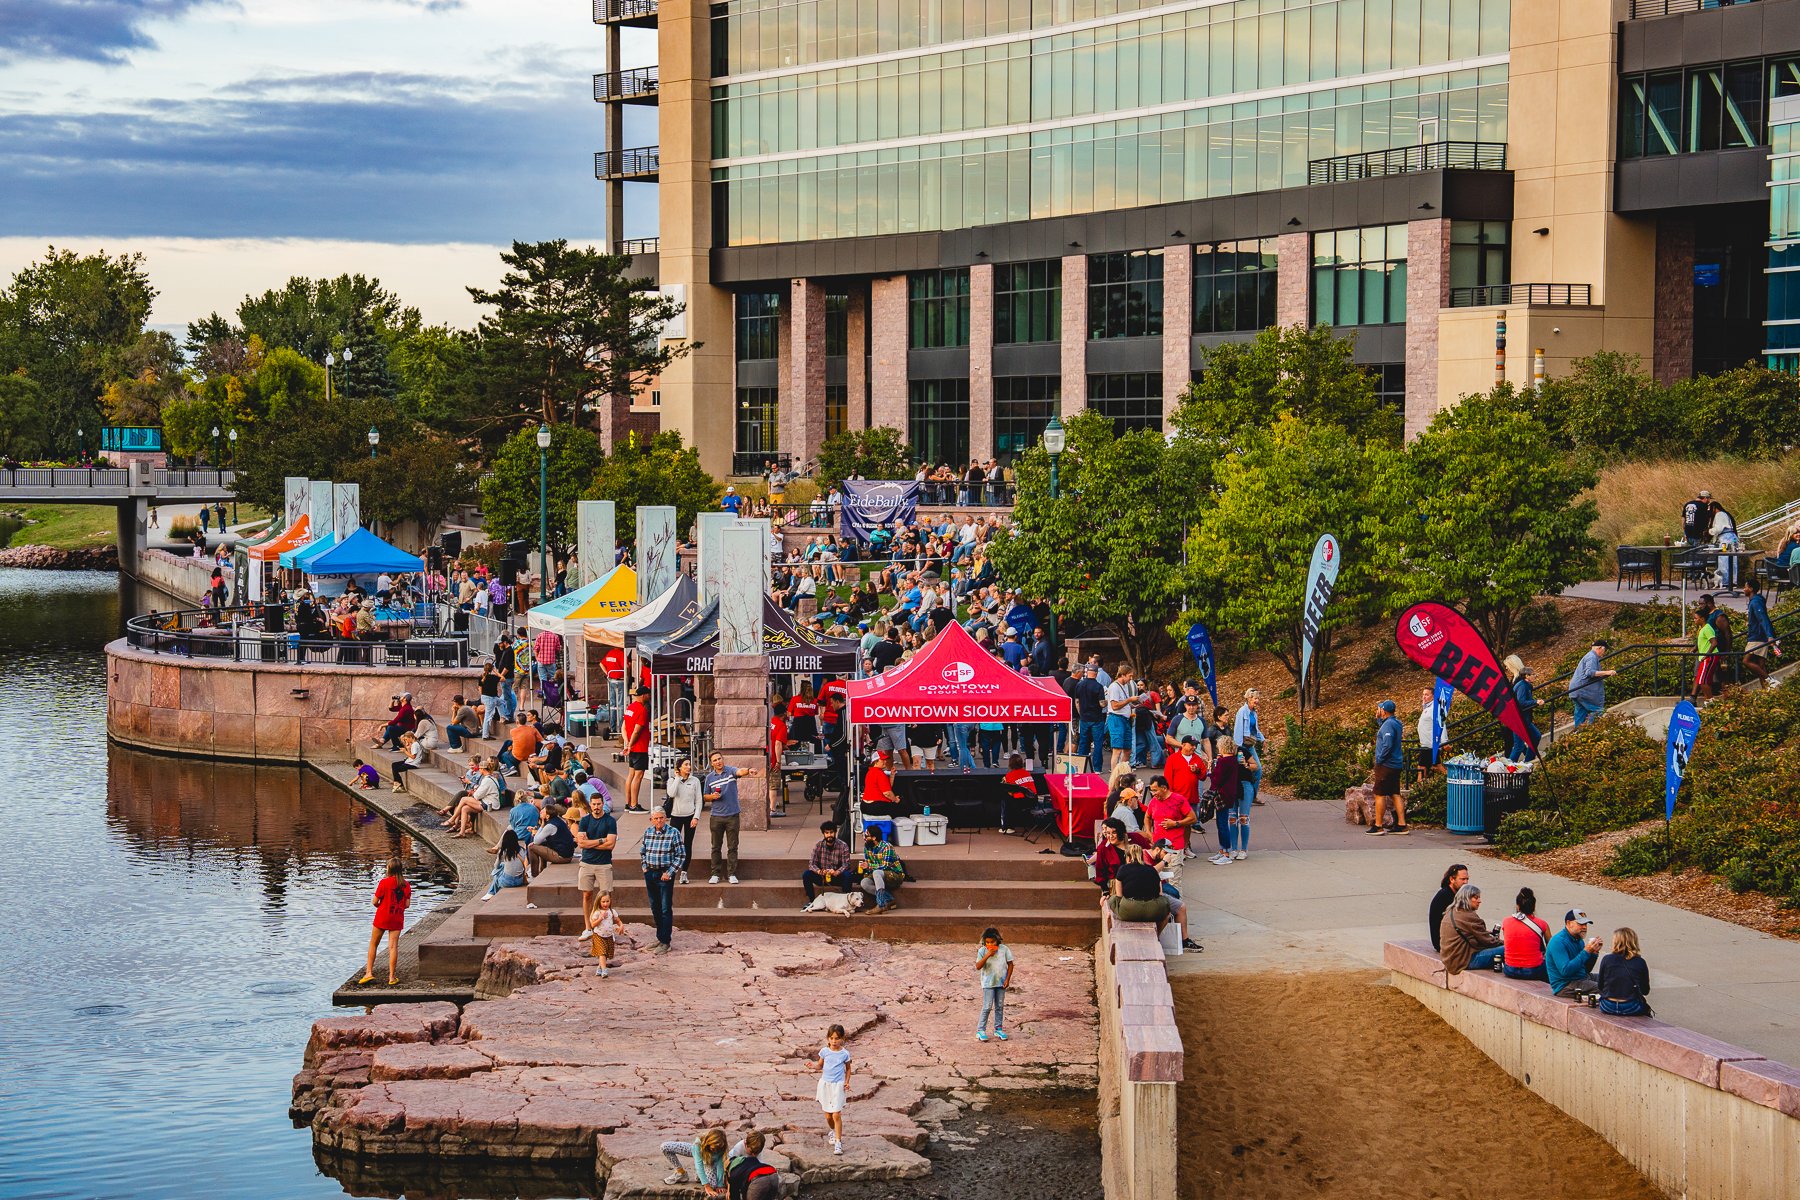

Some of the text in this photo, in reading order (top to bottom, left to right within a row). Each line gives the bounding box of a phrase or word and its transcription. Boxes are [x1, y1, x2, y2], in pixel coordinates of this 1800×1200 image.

[1303, 572, 1333, 647] BEER
[1412, 616, 1431, 633] DTSF
[796, 656, 823, 670] HERE
[944, 669, 972, 677] DTSF
[1430, 640, 1513, 718] BEER
[864, 705, 1057, 718] DOWNTOWN SIOUX FALLS
